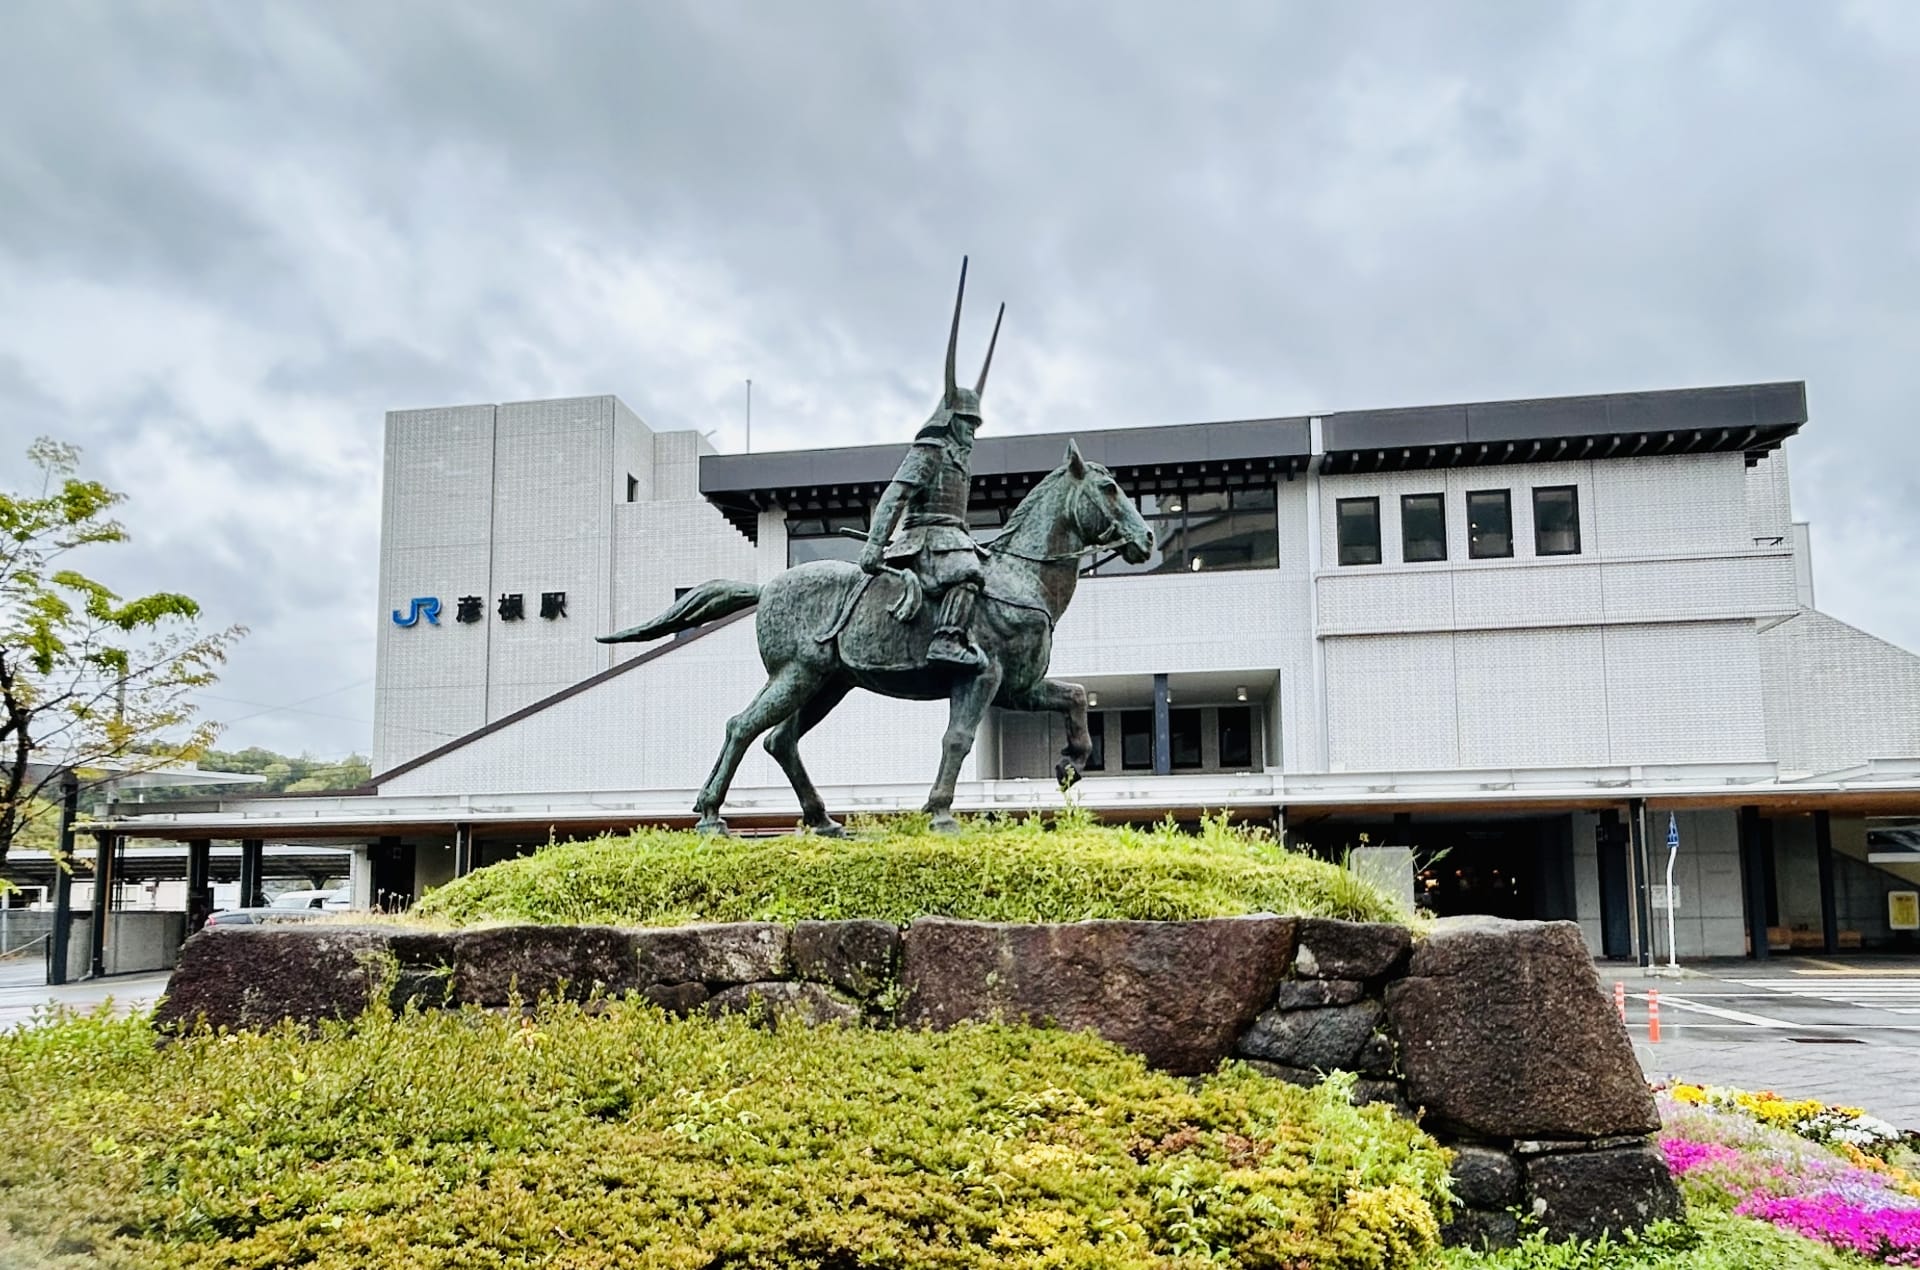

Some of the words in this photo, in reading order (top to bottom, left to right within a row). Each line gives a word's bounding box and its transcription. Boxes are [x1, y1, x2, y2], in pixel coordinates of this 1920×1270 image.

[392, 596, 441, 627] JR
[455, 592, 567, 623] 彦根駅
